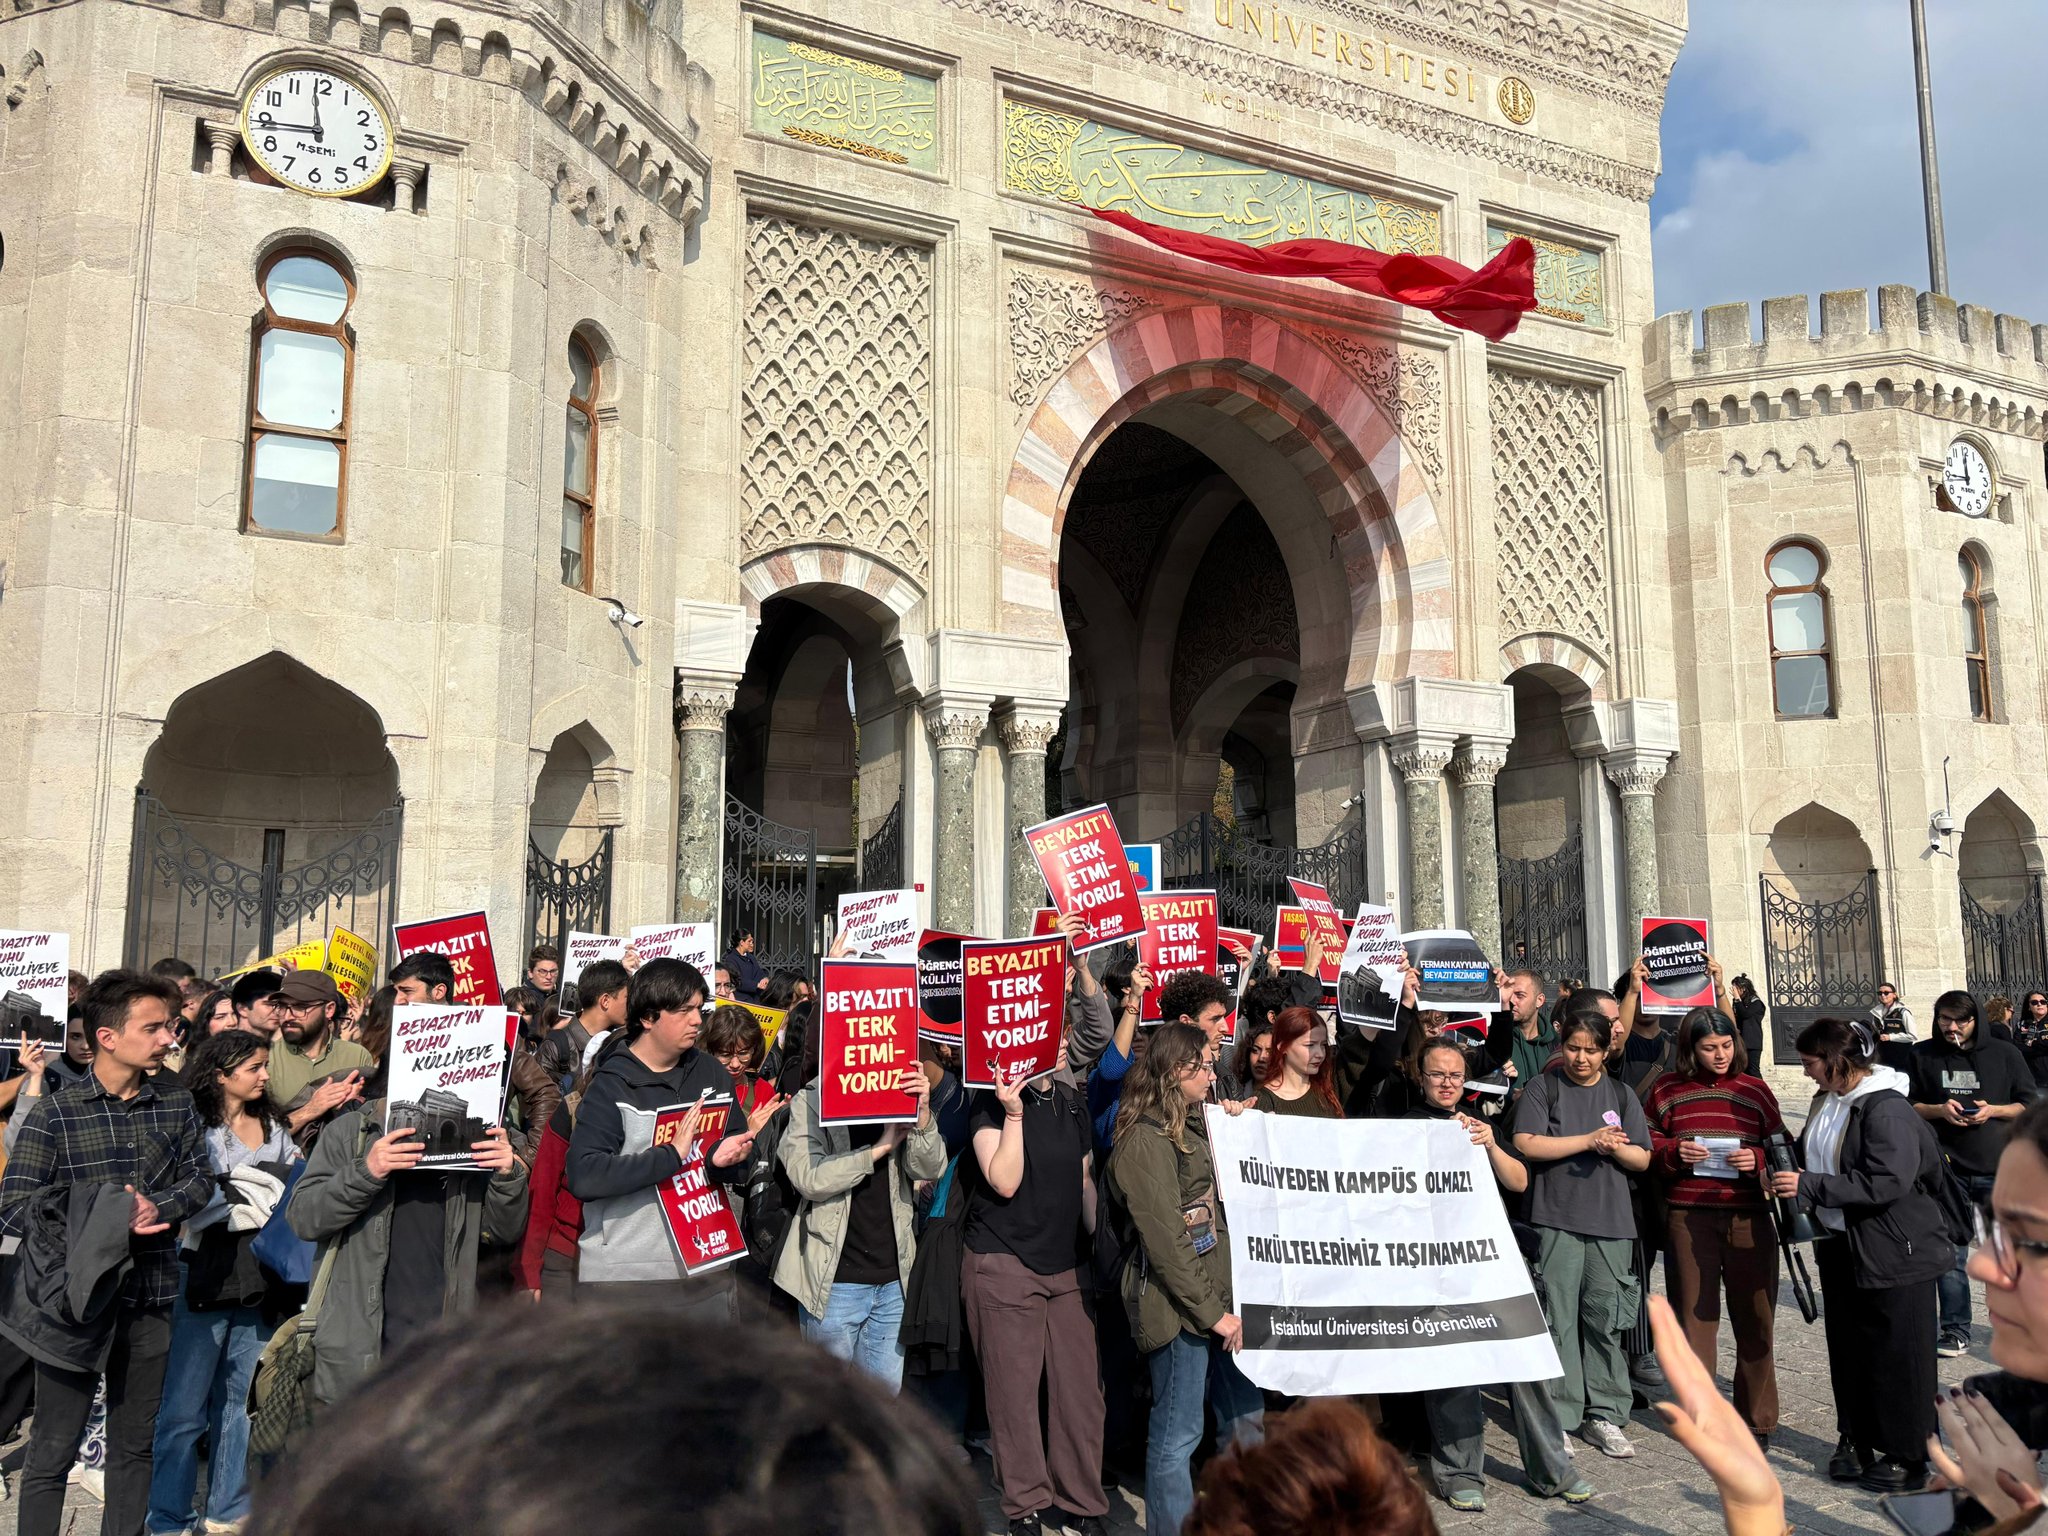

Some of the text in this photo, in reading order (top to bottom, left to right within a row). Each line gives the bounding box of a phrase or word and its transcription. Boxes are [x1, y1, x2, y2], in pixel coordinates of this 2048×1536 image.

[289, 78, 300, 95] 11
[267, 90, 282, 107] 10
[344, 90, 349, 105] 1
[357, 110, 370, 127] 2
[264, 135, 277, 152] 8
[363, 134, 377, 151] 3
[282, 155, 296, 171] 7
[353, 156, 368, 171] 4
[308, 168, 321, 183] 6
[335, 167, 348, 183] 5
[1978, 463, 1983, 473] 2
[1949, 484, 1954, 494] 8
[1983, 477, 1988, 487] 3
[1957, 496, 1962, 505] 7
[1976, 499, 1981, 509] 5
[1981, 491, 1987, 500] 4
[1967, 501, 1972, 511] 6
[1033, 813, 1111, 856] BEYAZIT'I
[1058, 839, 1106, 868] TERK
[1066, 857, 1117, 890] ETMİ-
[841, 892, 899, 917] BEYAZIT'IN
[1070, 880, 1125, 912] YORUZ
[1141, 899, 1214, 921] BEYAZIT'I
[846, 913, 877, 929] RUHU
[853, 918, 909, 941] KÜLLİYEYE
[1100, 914, 1123, 931] EHP
[1314, 915, 1337, 930] TERK
[634, 926, 695, 948] BEYAZIT'IN
[1157, 922, 1200, 942] TERK
[1356, 928, 1384, 940] RUHU
[0, 934, 50, 949] YAZIT'IN
[570, 938, 621, 949] BEYAZIT'IN
[870, 931, 915, 951] SIĞMAZ!
[1644, 941, 1705, 957] ÖĞRENCİLER
[0, 951, 25, 963] UHU
[572, 950, 600, 958] RUHU
[639, 945, 672, 961] RUHU
[675, 950, 706, 963] İYEYE
[967, 944, 1062, 976] BEYAZIT'I
[1158, 941, 1206, 965] ETMİ-
[1367, 953, 1402, 966] SIĞMAZ
[1649, 953, 1704, 968] KÜLLİYEYE
[449, 956, 474, 975] RK
[919, 958, 962, 971] ÖĞRENCİ
[1420, 960, 1490, 969] FERMAN KAYYUMUN
[16, 975, 66, 990] SIĞMAZ!
[921, 973, 962, 985] KÜLLİYE
[1425, 971, 1453, 979] BEYAZIT
[453, 974, 484, 997] Mİ-
[987, 973, 1043, 999] TERK
[826, 987, 914, 1012] BEYAZIT'I
[987, 994, 1051, 1025] ETMİ-
[397, 1009, 484, 1036] BEYAZIT'IN
[845, 1015, 897, 1038] TERK
[982, 1020, 1049, 1049] YORUZ
[403, 1034, 451, 1054] RUHU
[844, 1038, 905, 1067] ETMİ-
[412, 1044, 494, 1072] KÜLLİYEYE
[1009, 1057, 1038, 1074] EHP
[437, 1062, 501, 1087] SIĞMAZ!
[838, 1068, 904, 1095] YORUZ
[655, 1110, 726, 1145] BEIT'I
[672, 1160, 711, 1197] ETMİ
[1239, 1156, 1473, 1194] KÜLLİYEDEN KAMPÜS OLMAZ!
[678, 1188, 724, 1223] YORUZ
[708, 1229, 727, 1247] EHP
[1247, 1233, 1500, 1269] FAKÜLTELERİMİZ TAŞINAMAZ!
[1270, 1313, 1498, 1337] İstanbul Üniversitesi Öğrencileri
